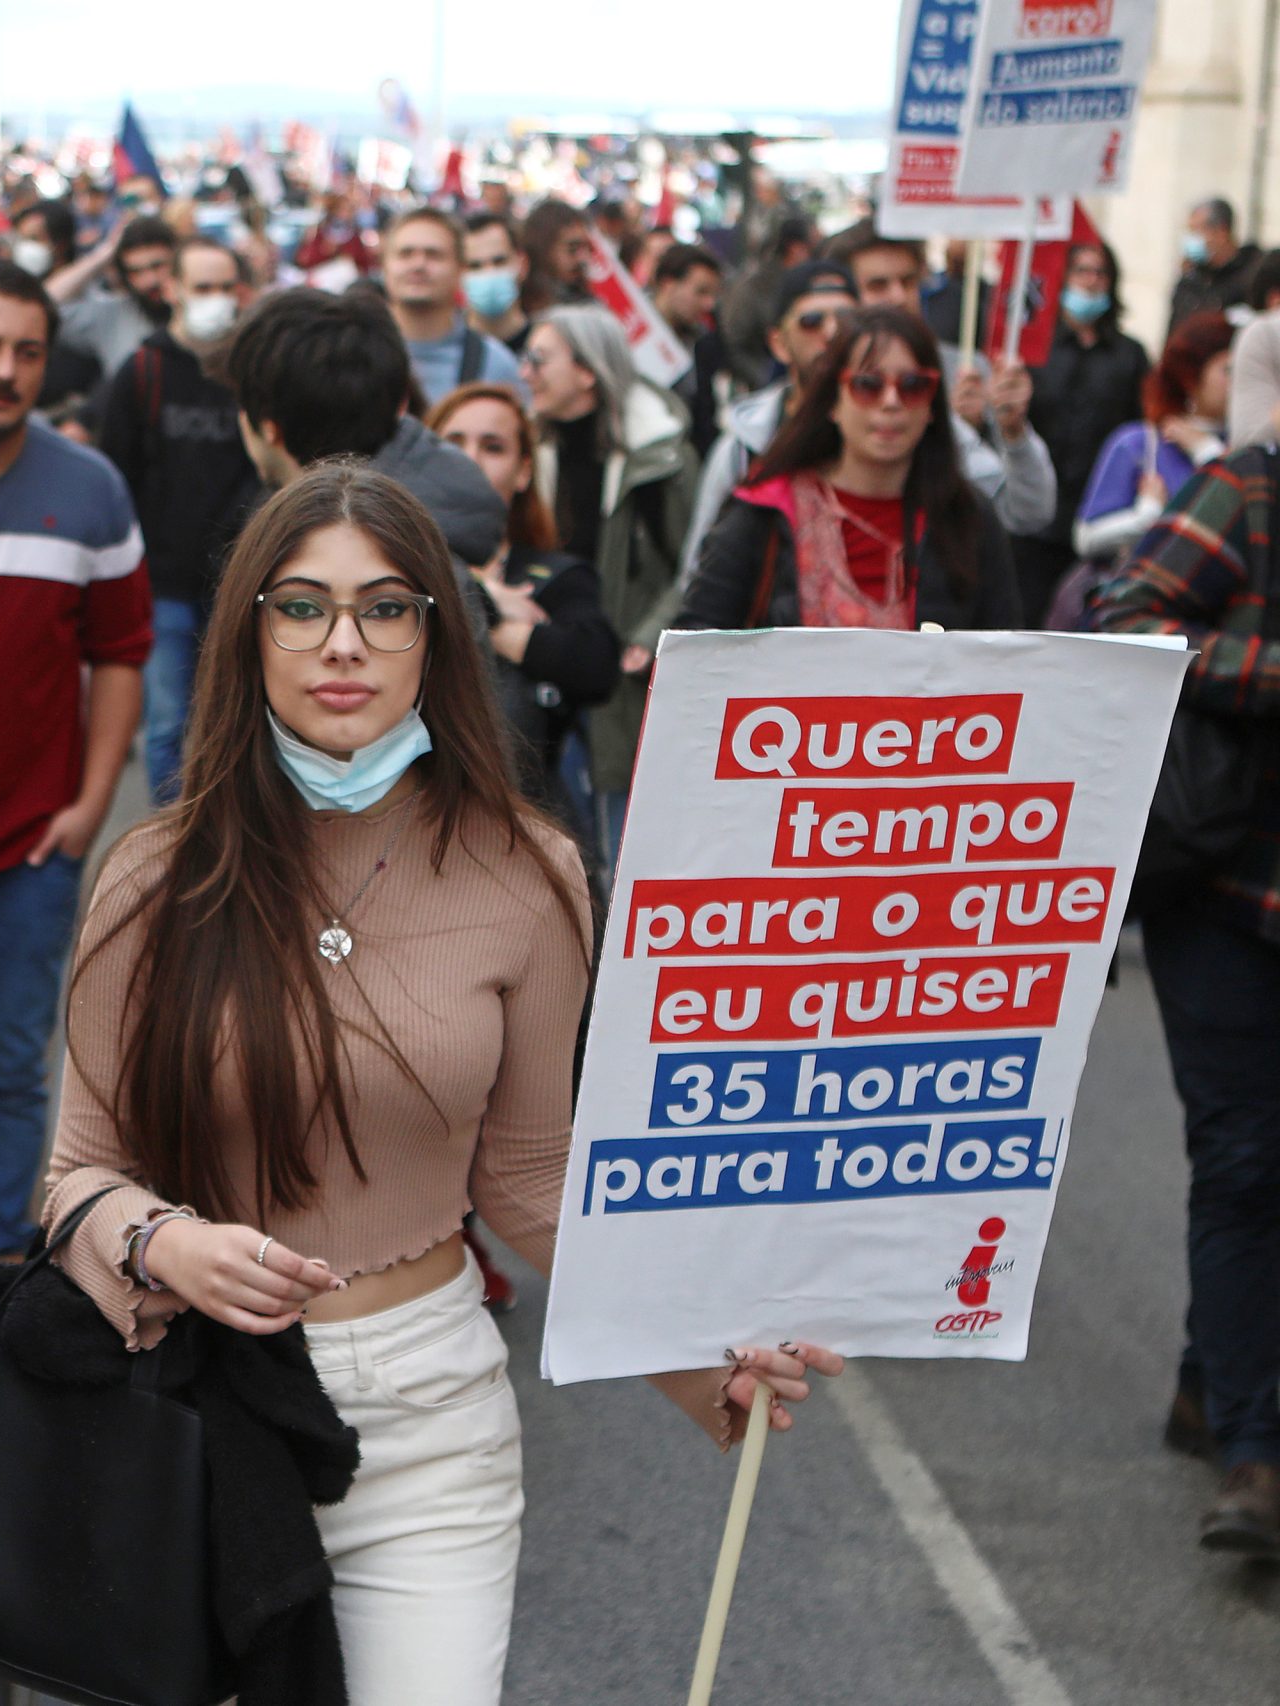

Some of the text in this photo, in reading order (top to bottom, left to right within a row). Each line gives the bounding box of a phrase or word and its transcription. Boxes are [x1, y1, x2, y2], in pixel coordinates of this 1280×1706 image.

[910, 61, 968, 94] Vid
[997, 46, 1121, 85] Aumento
[979, 92, 1017, 123] do
[731, 704, 1004, 777] Quero
[789, 797, 1058, 864] tempo
[632, 876, 1106, 959] para o que
[657, 957, 1052, 1040] eu quiser
[666, 1052, 1027, 1126] 35 horas
[590, 1116, 1061, 1217] para todos!
[934, 1310, 1004, 1333] CGTP
